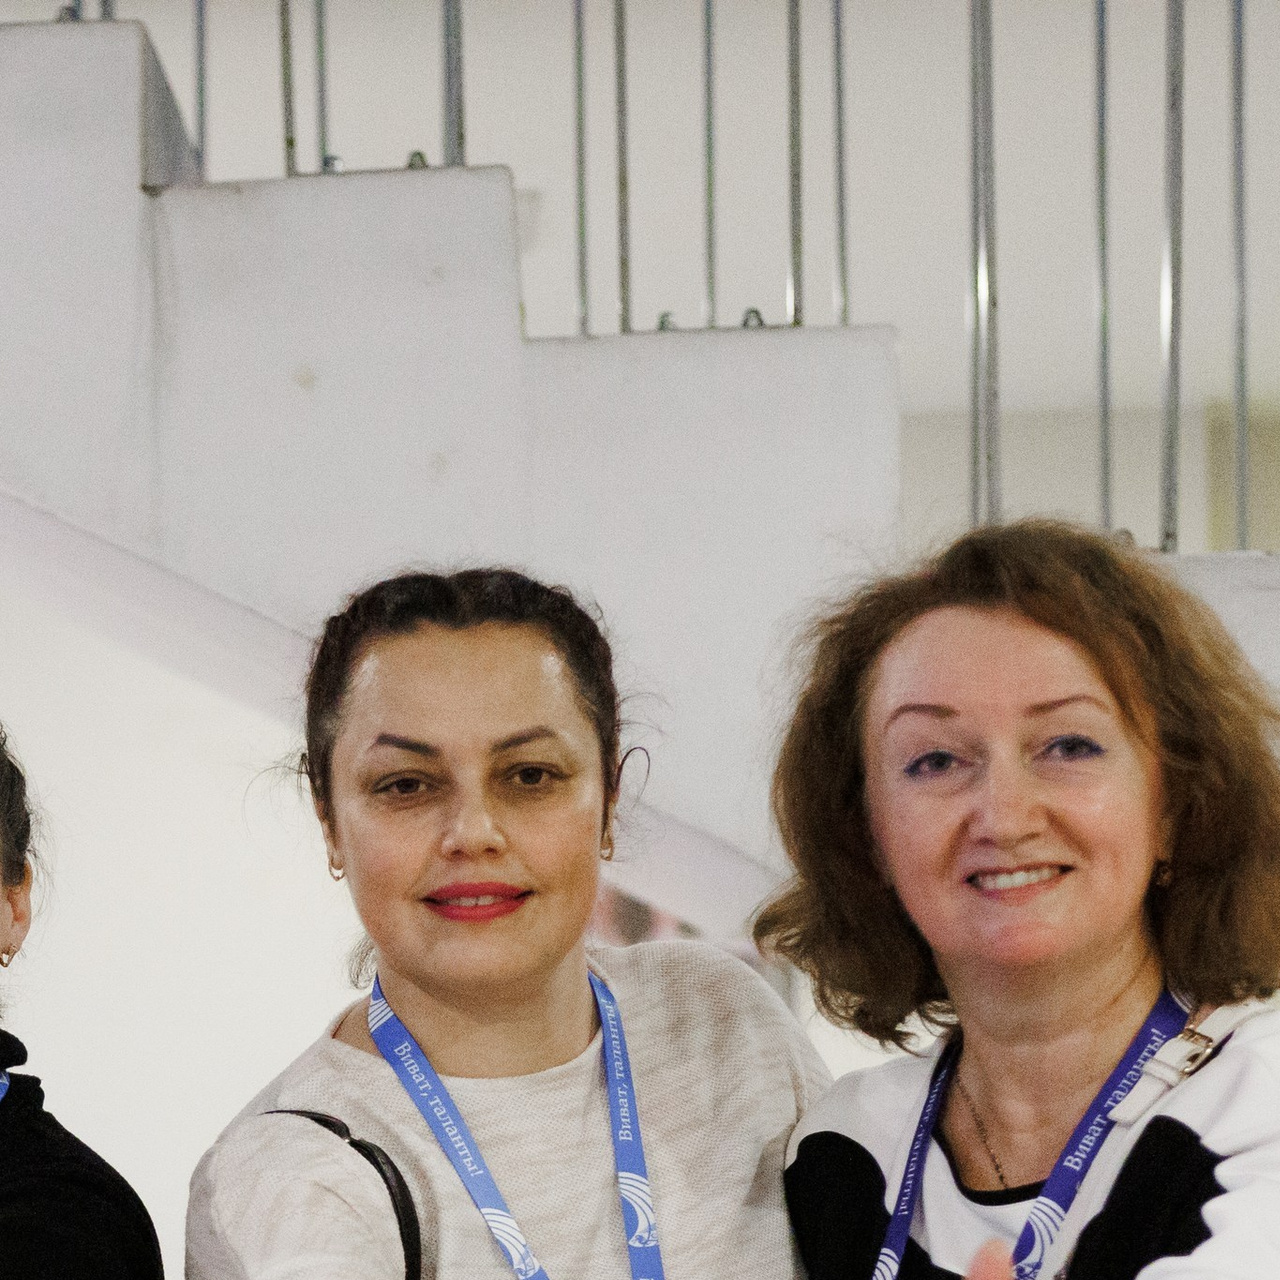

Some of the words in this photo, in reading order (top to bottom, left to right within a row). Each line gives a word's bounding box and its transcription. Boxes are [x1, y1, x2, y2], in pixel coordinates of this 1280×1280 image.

[602, 998, 625, 1080] таланты!
[393, 1041, 433, 1097] Виват,
[429, 1095, 484, 1177] таланты!
[618, 1082, 634, 1142] Виват,
[1063, 1113, 1108, 1172] Виват
[1104, 1027, 1168, 1110] таланты!
